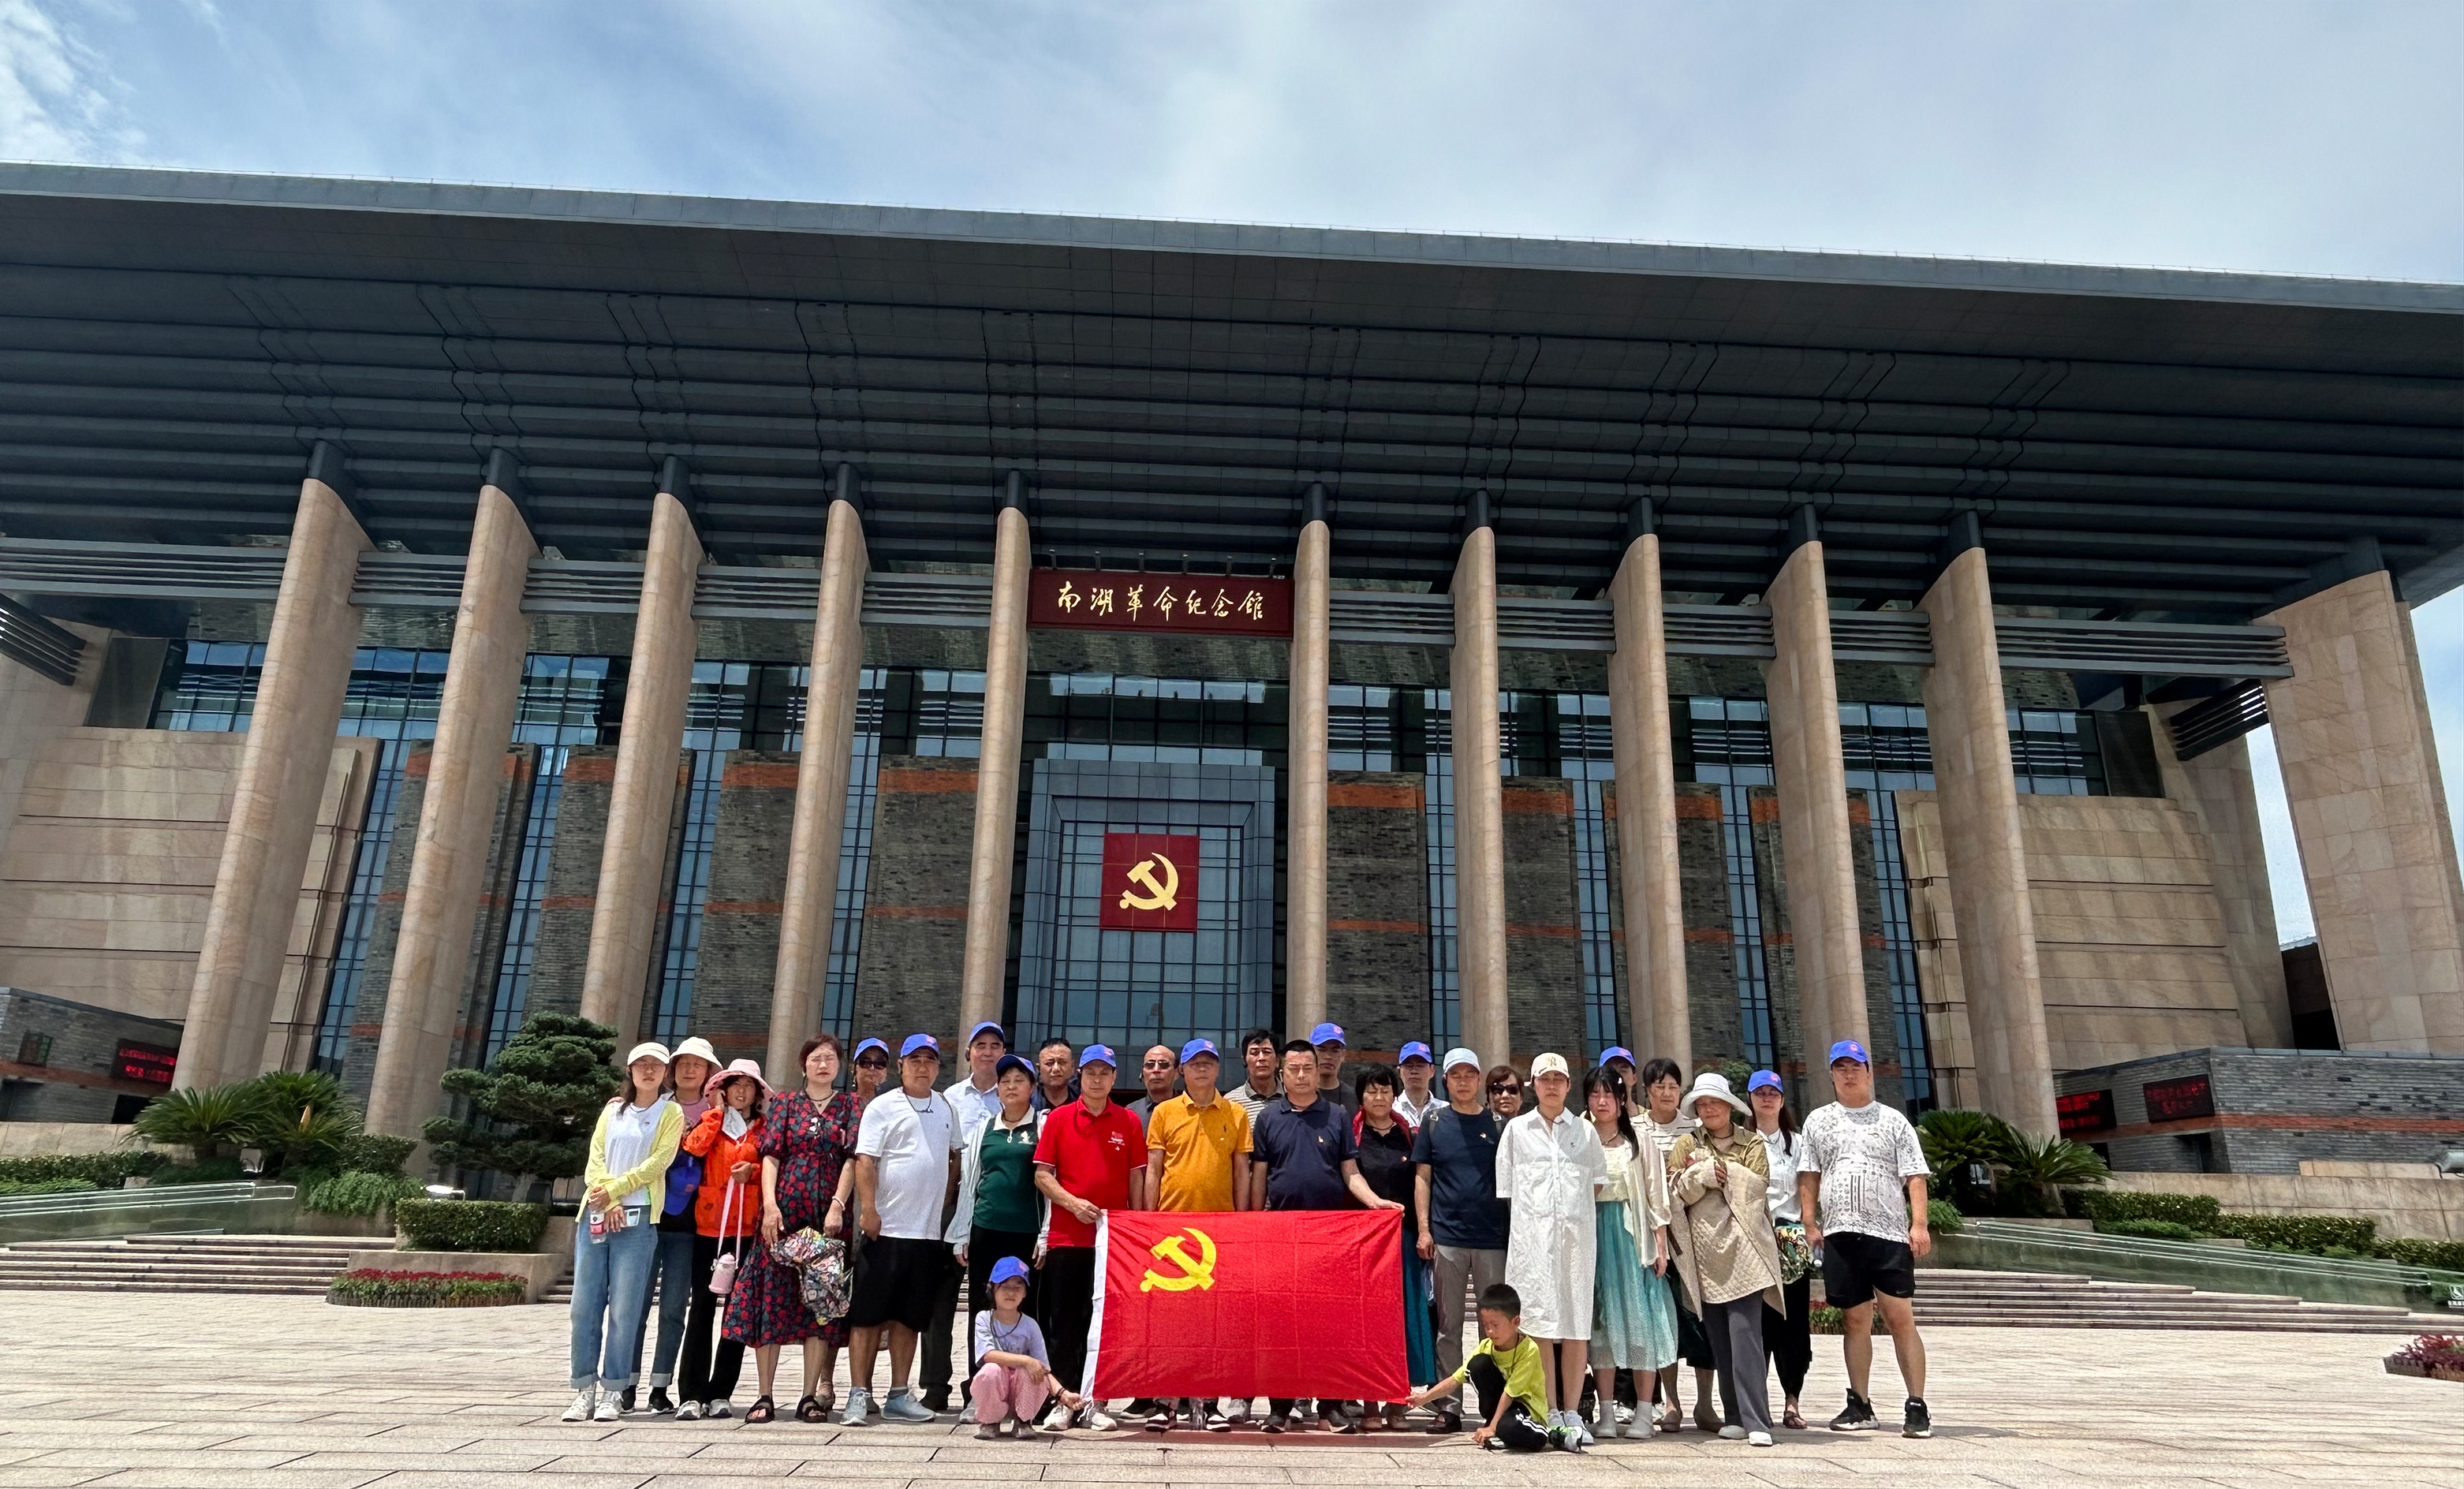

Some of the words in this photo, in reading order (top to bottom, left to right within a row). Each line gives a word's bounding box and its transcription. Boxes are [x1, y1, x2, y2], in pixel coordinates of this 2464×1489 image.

[1058, 580, 1264, 621] 南湖革命纪念馆
